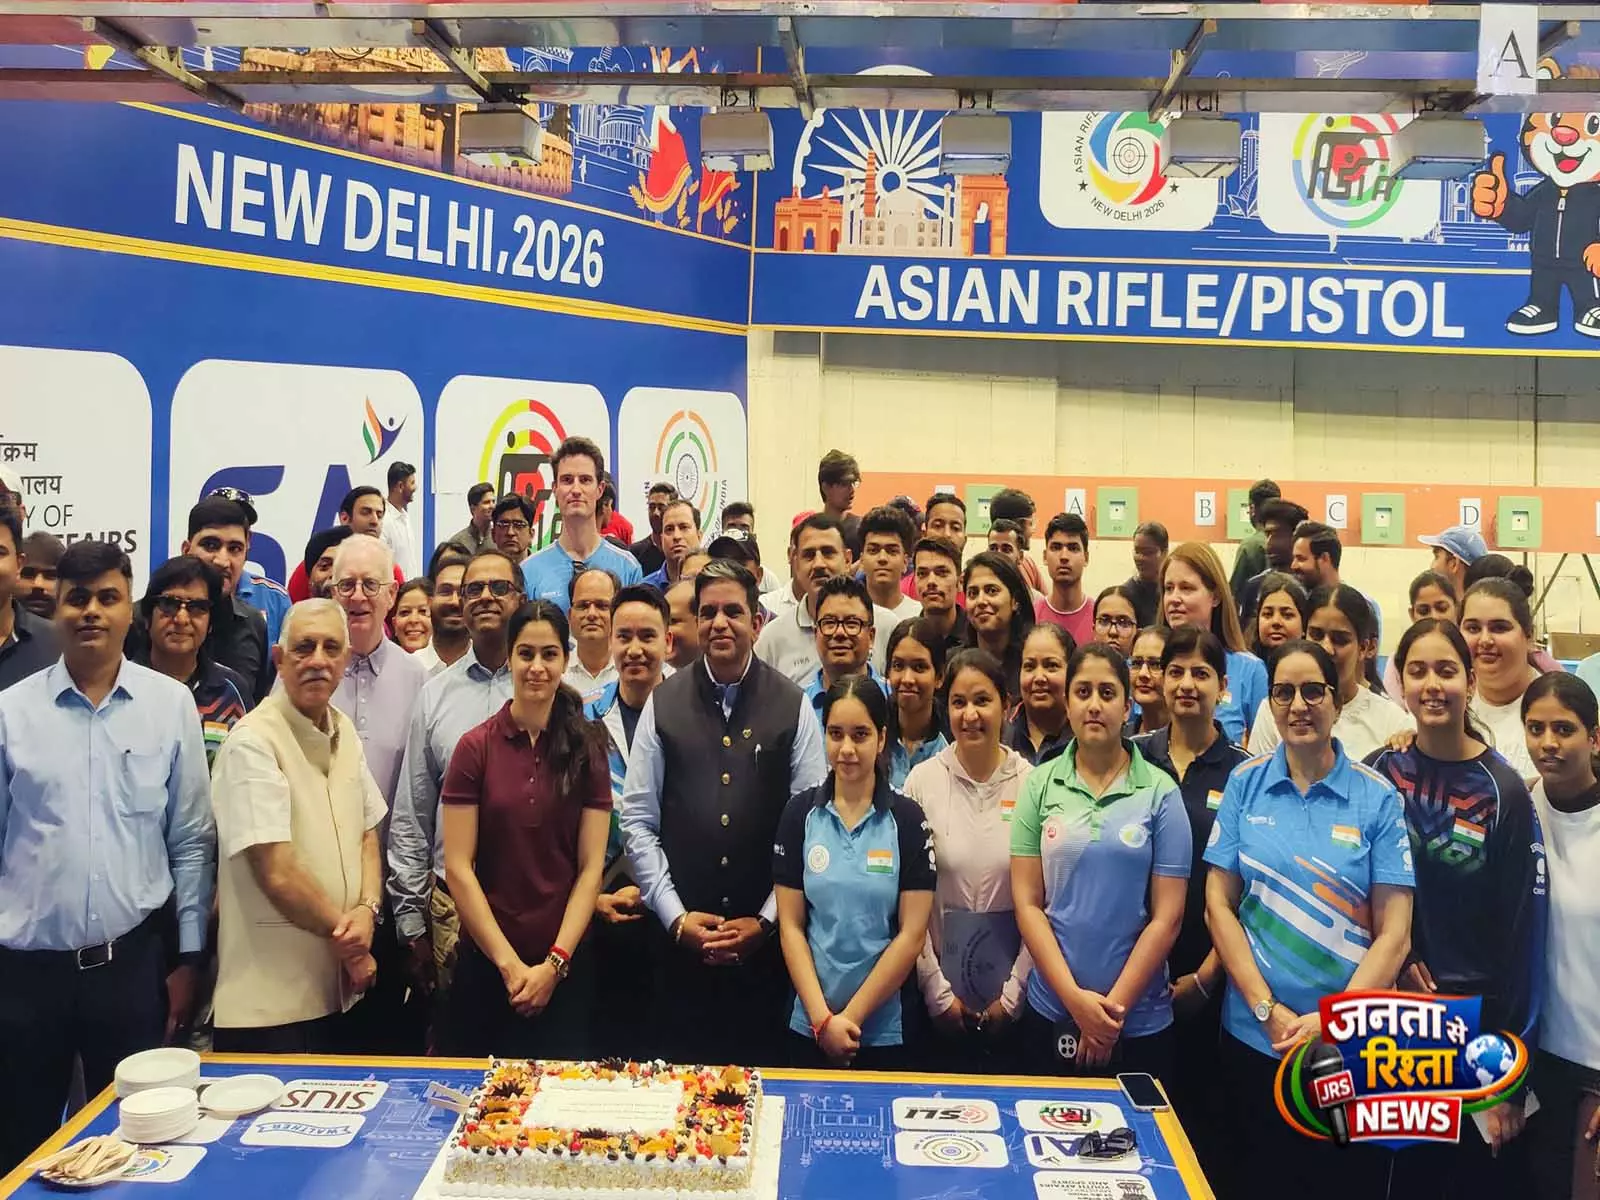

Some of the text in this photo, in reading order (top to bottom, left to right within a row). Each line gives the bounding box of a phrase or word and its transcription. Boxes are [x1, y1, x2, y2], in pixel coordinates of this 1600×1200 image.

[1487, 29, 1534, 79] A
[1073, 111, 1100, 173] ASIAN RIFL
[174, 142, 333, 247] NEW
[1091, 196, 1166, 222] NEW DELHI 2026
[854, 263, 1466, 339] ASIAN RIFLE/PISTOL
[43, 503, 74, 528] OF
[1068, 495, 1084, 516] A
[1199, 498, 1212, 519] B
[1328, 501, 1345, 522] C
[1462, 505, 1480, 526] D
[279, 1088, 375, 1110] SIUS
[904, 1108, 962, 1120] SLI
